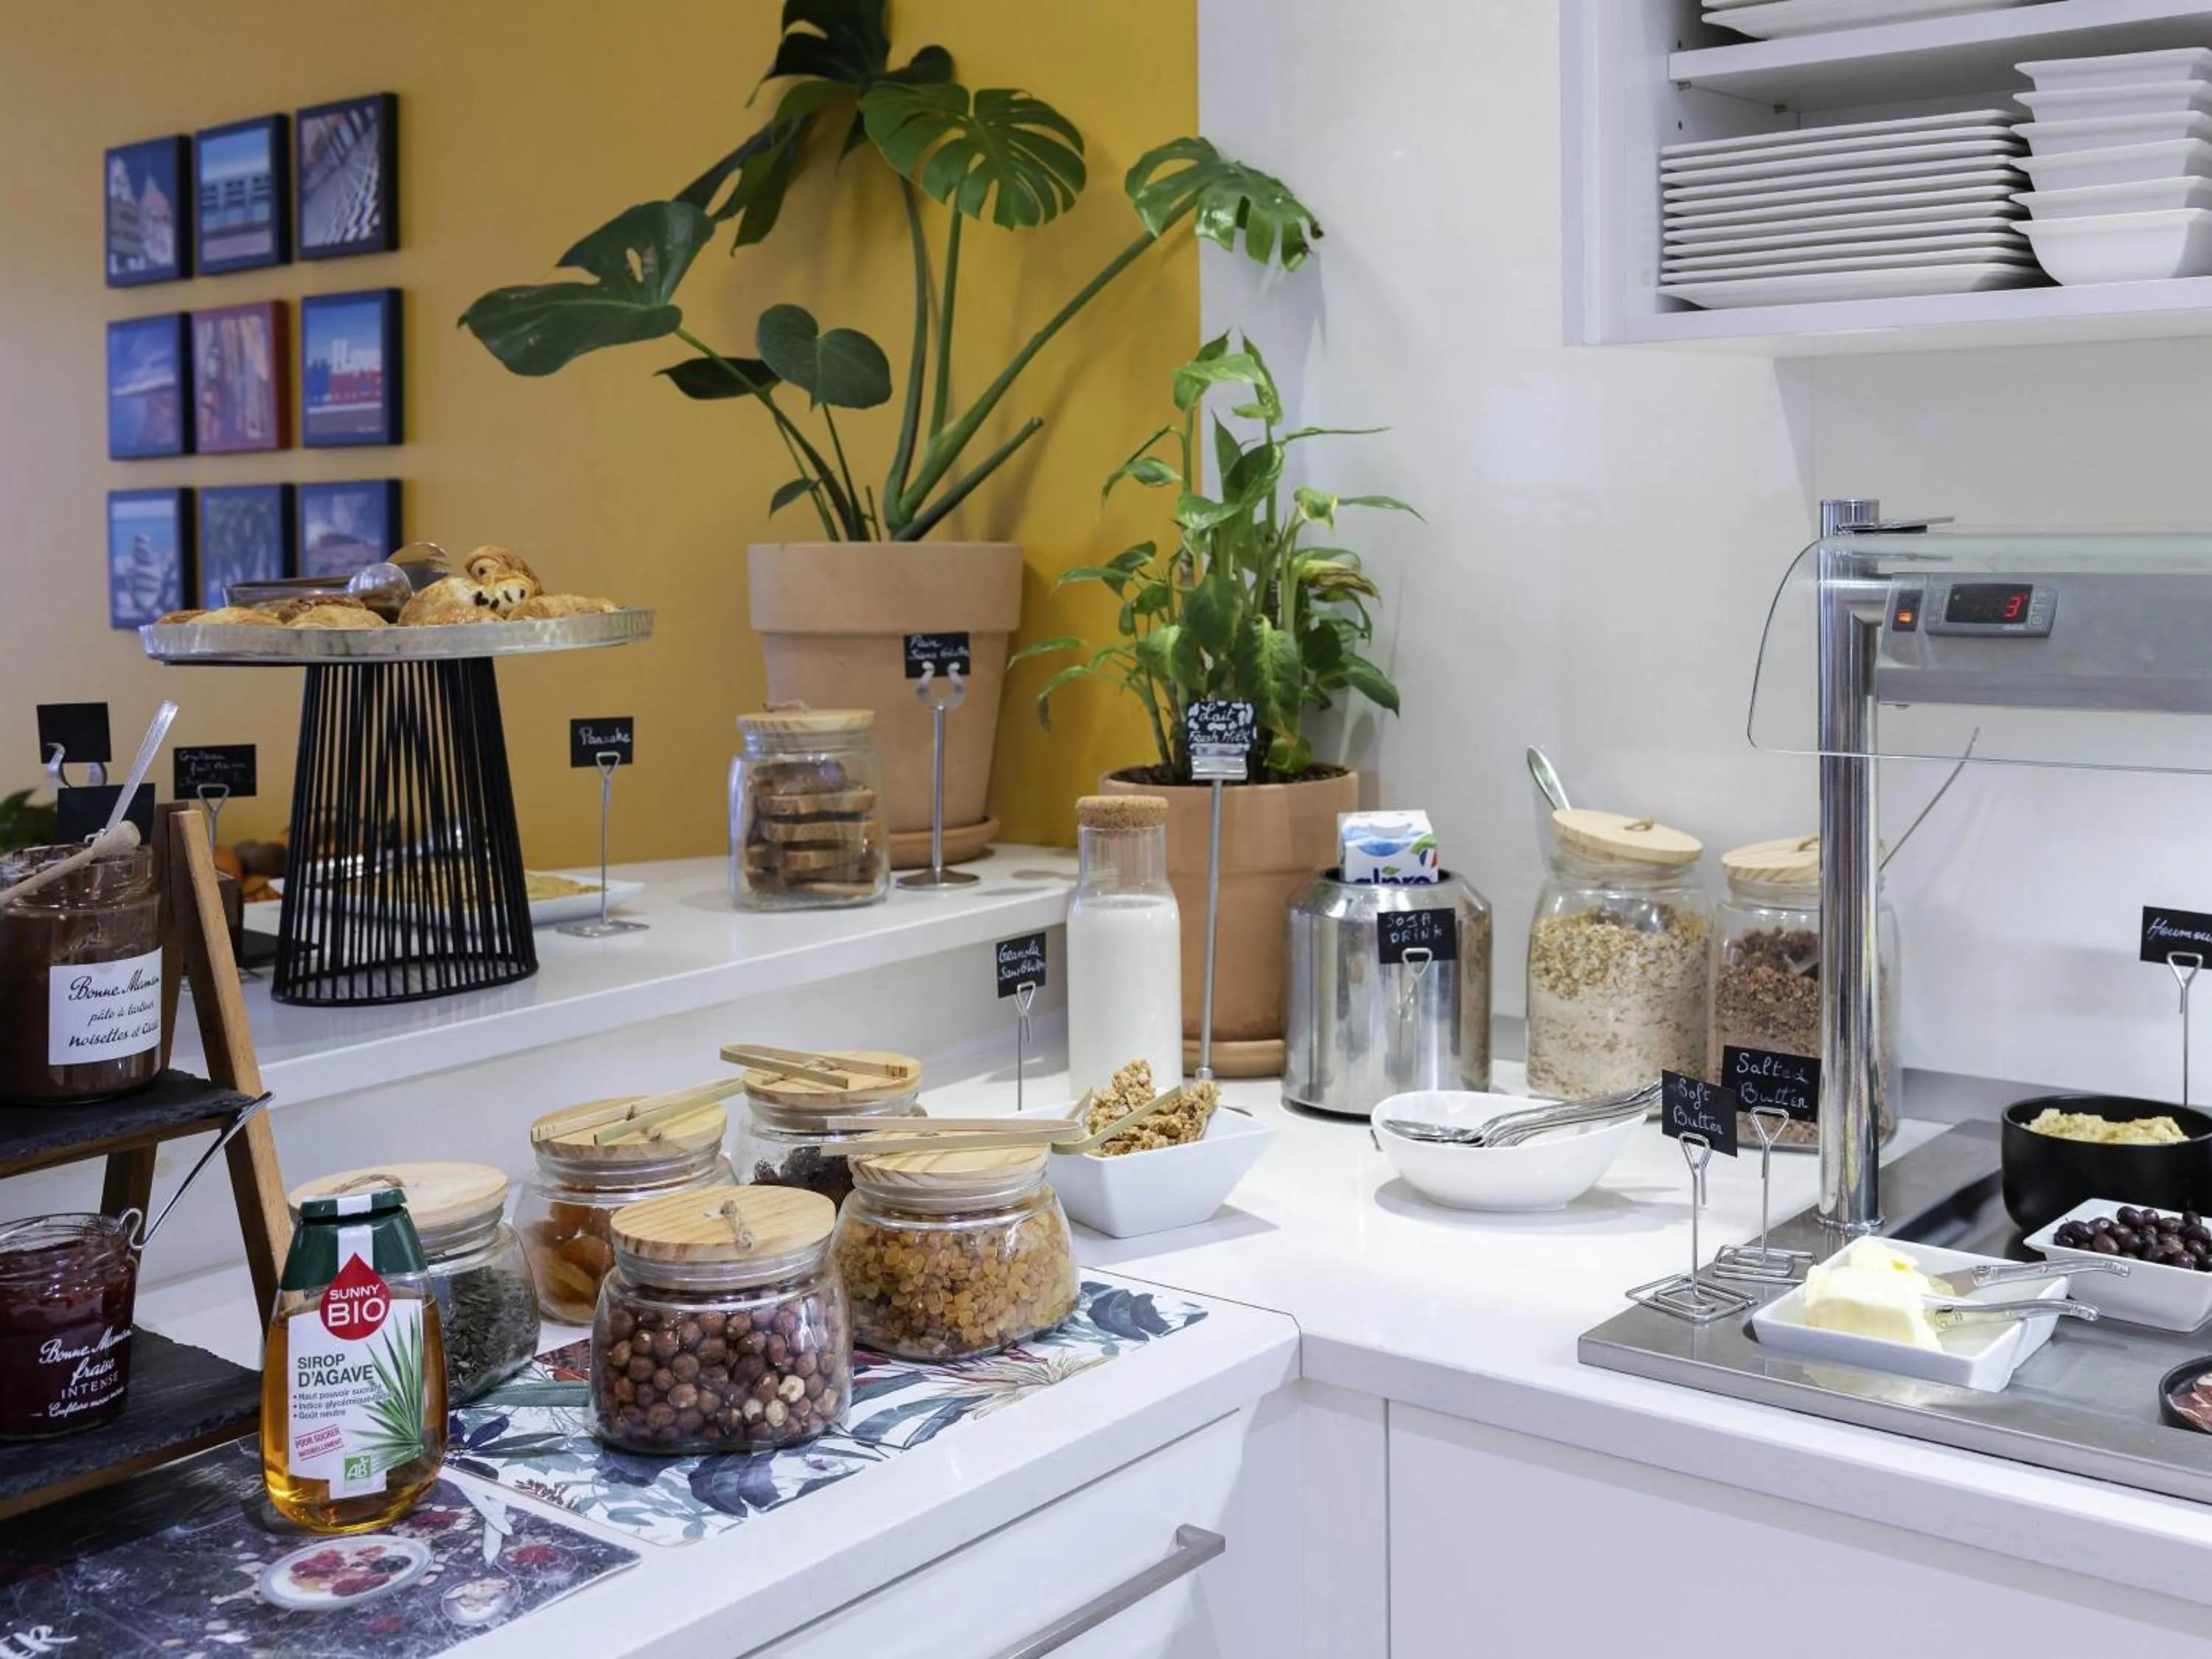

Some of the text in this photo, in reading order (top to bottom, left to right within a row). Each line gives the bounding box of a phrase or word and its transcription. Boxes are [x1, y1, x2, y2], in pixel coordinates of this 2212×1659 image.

[2146, 917, 2212, 944] Houmou
[69, 975, 119, 1001] Bonne
[87, 1008, 115, 1026] pâte
[69, 1027, 128, 1048] noisettes
[1736, 1052, 1809, 1084] Salted
[1677, 1077, 1711, 1110] Soft
[1741, 1081, 1809, 1109] Butter
[1673, 1105, 1725, 1135] Butter
[330, 1284, 380, 1300] SUNNY
[328, 1297, 385, 1327] BIO
[39, 1338, 90, 1364] Bonne
[297, 1354, 345, 1369] SIROP
[61, 1371, 119, 1399] INTENSE
[298, 1363, 374, 1388] D'AGAVE
[299, 1391, 317, 1400] Haut
[319, 1389, 350, 1400] pouvoir
[299, 1402, 322, 1411] Indice
